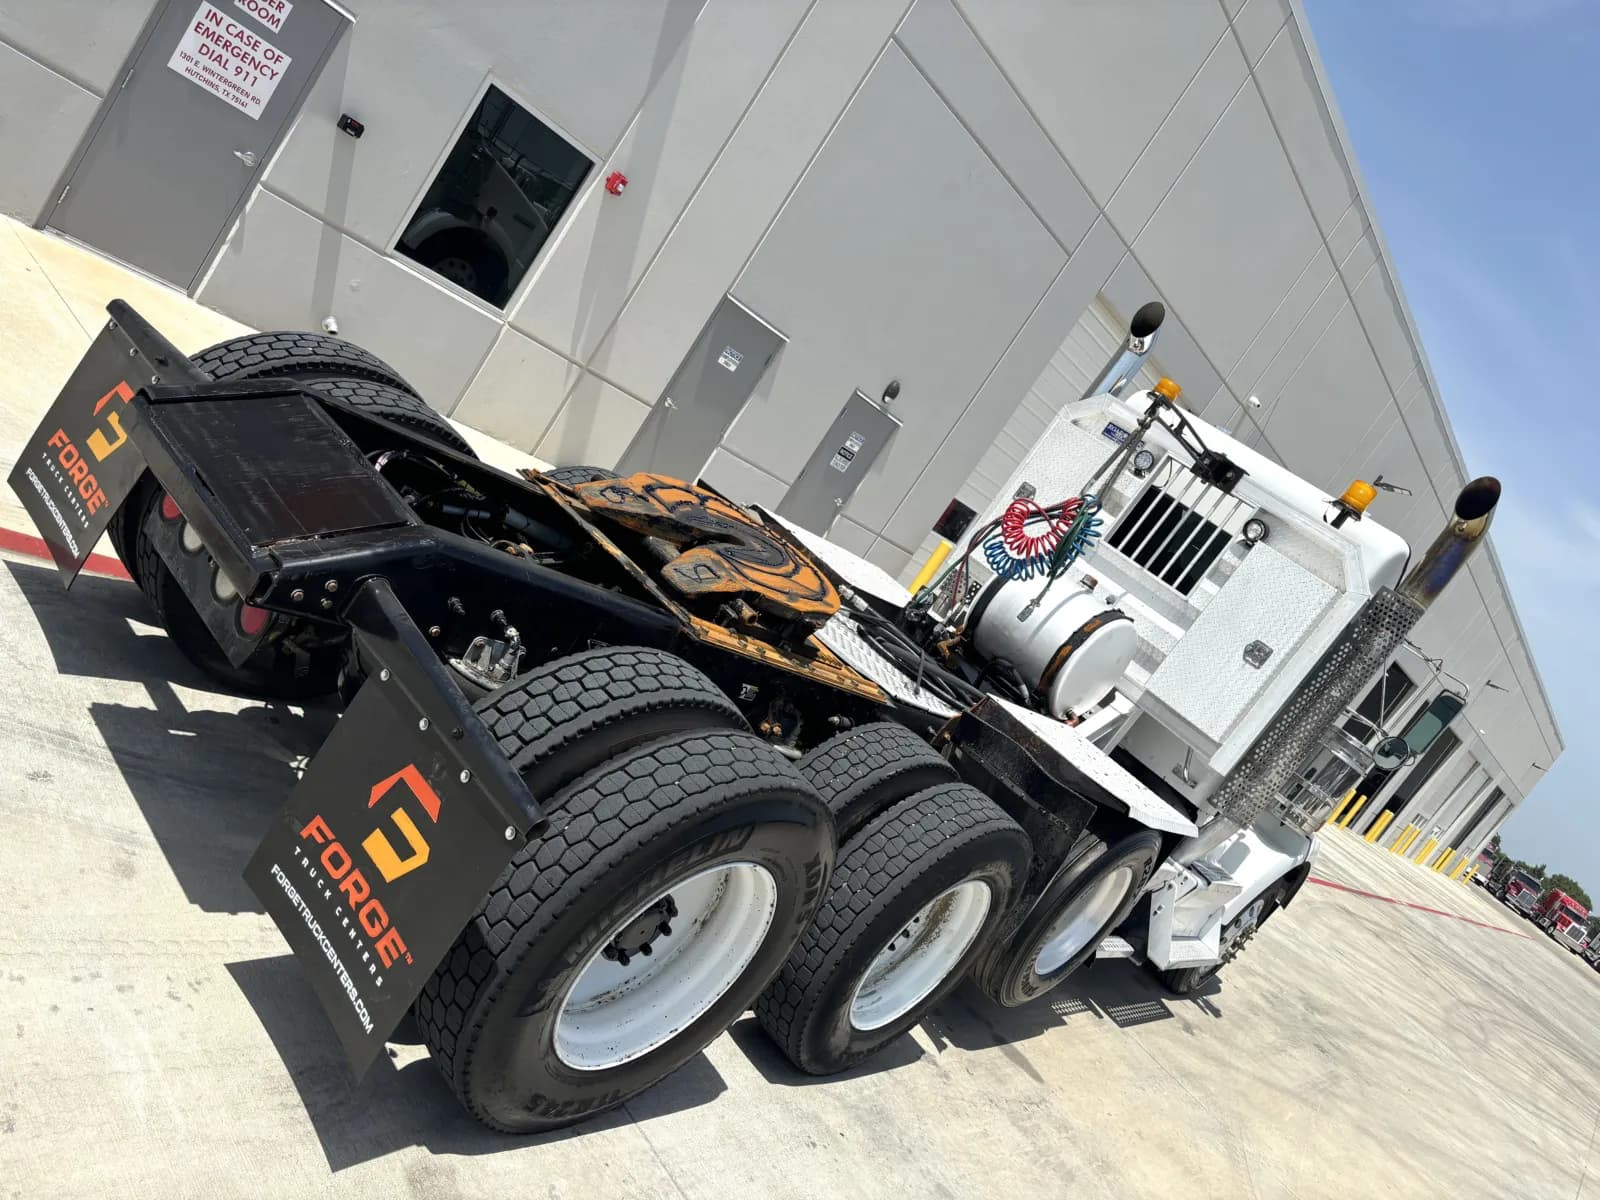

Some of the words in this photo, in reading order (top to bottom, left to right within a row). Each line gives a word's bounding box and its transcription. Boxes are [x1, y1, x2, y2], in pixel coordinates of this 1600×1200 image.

[194, 21, 279, 81] EMERGENCY
[198, 43, 228, 71] DIAL
[234, 65, 258, 88] 911
[204, 9, 223, 27] IN
[226, 23, 262, 51] CASE
[264, 48, 284, 65] OF
[184, 66, 220, 96] HUTCHINS,
[222, 88, 231, 98] TX
[202, 64, 250, 99] WINTERGREEN
[251, 95, 261, 105] RD
[48, 428, 106, 516] FORGE
[294, 846, 332, 900] TRUCK
[336, 906, 383, 988] CENTERS
[300, 814, 407, 969] FORGE
[271, 864, 374, 1034] FORGETRUCKCENTERS.COM
